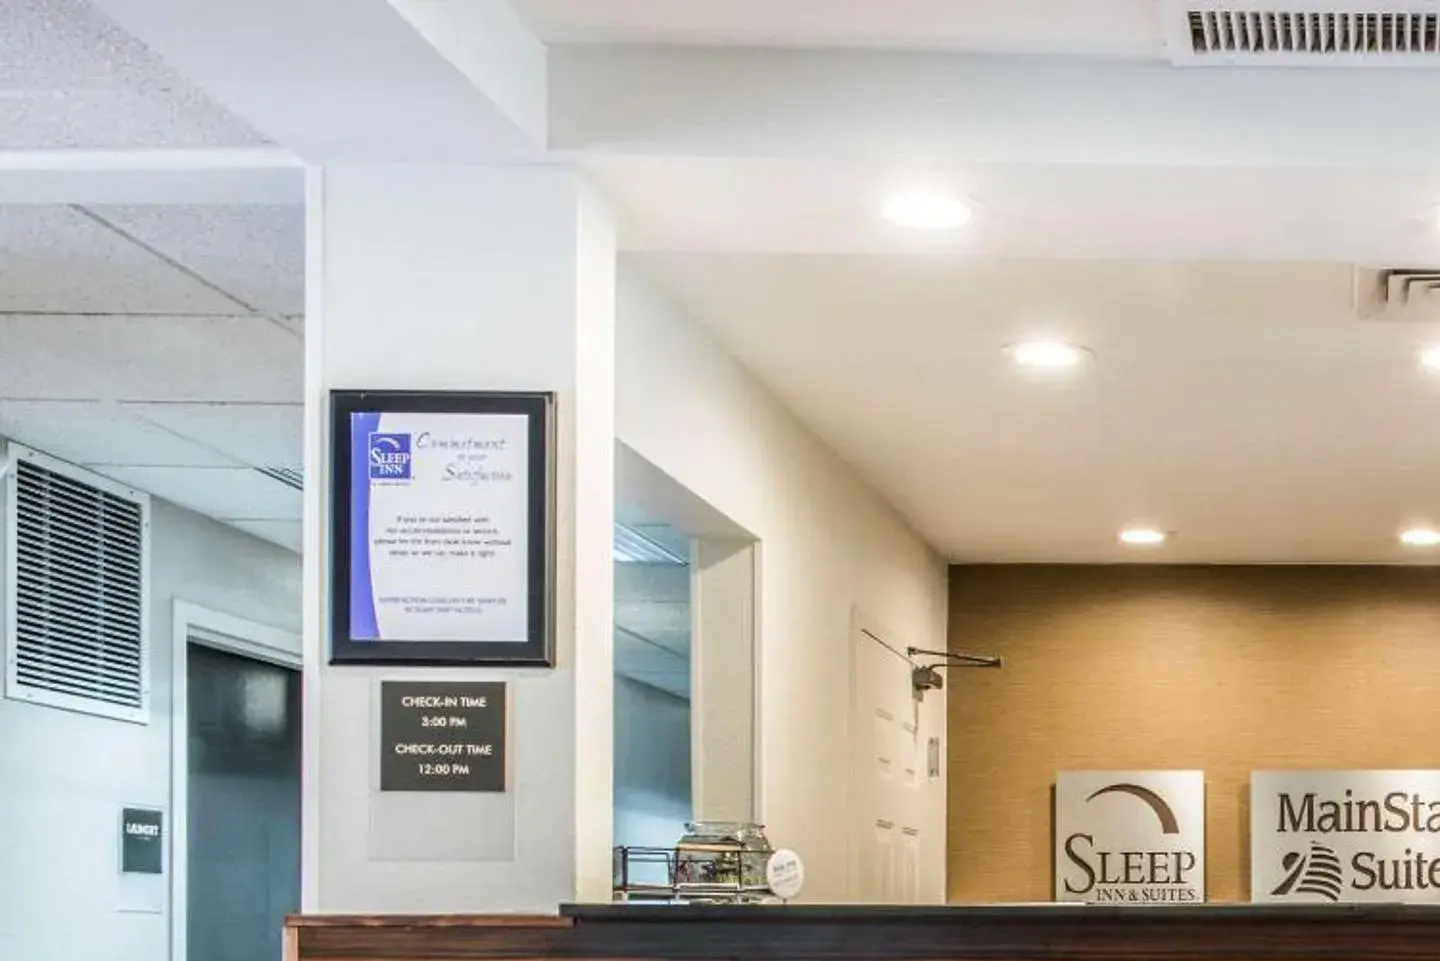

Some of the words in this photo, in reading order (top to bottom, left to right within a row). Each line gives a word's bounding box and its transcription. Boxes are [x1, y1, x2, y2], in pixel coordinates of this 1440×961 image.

[417, 431, 507, 450] Commitment
[371, 447, 411, 467] SLEEP
[380, 464, 403, 475] INN
[402, 696, 458, 708] CHECK-IN
[460, 696, 487, 708] TIME
[421, 715, 447, 727] 3:00
[449, 716, 467, 728] PM
[395, 743, 463, 755] CHECK-OUT
[467, 744, 493, 756] TIME
[418, 763, 450, 775] 12:00
[453, 764, 470, 775] PM
[1064, 832, 1196, 894] SLEEP
[1097, 888, 1125, 901] INN
[1128, 887, 1139, 901] &
[1141, 887, 1196, 901] SUITES
